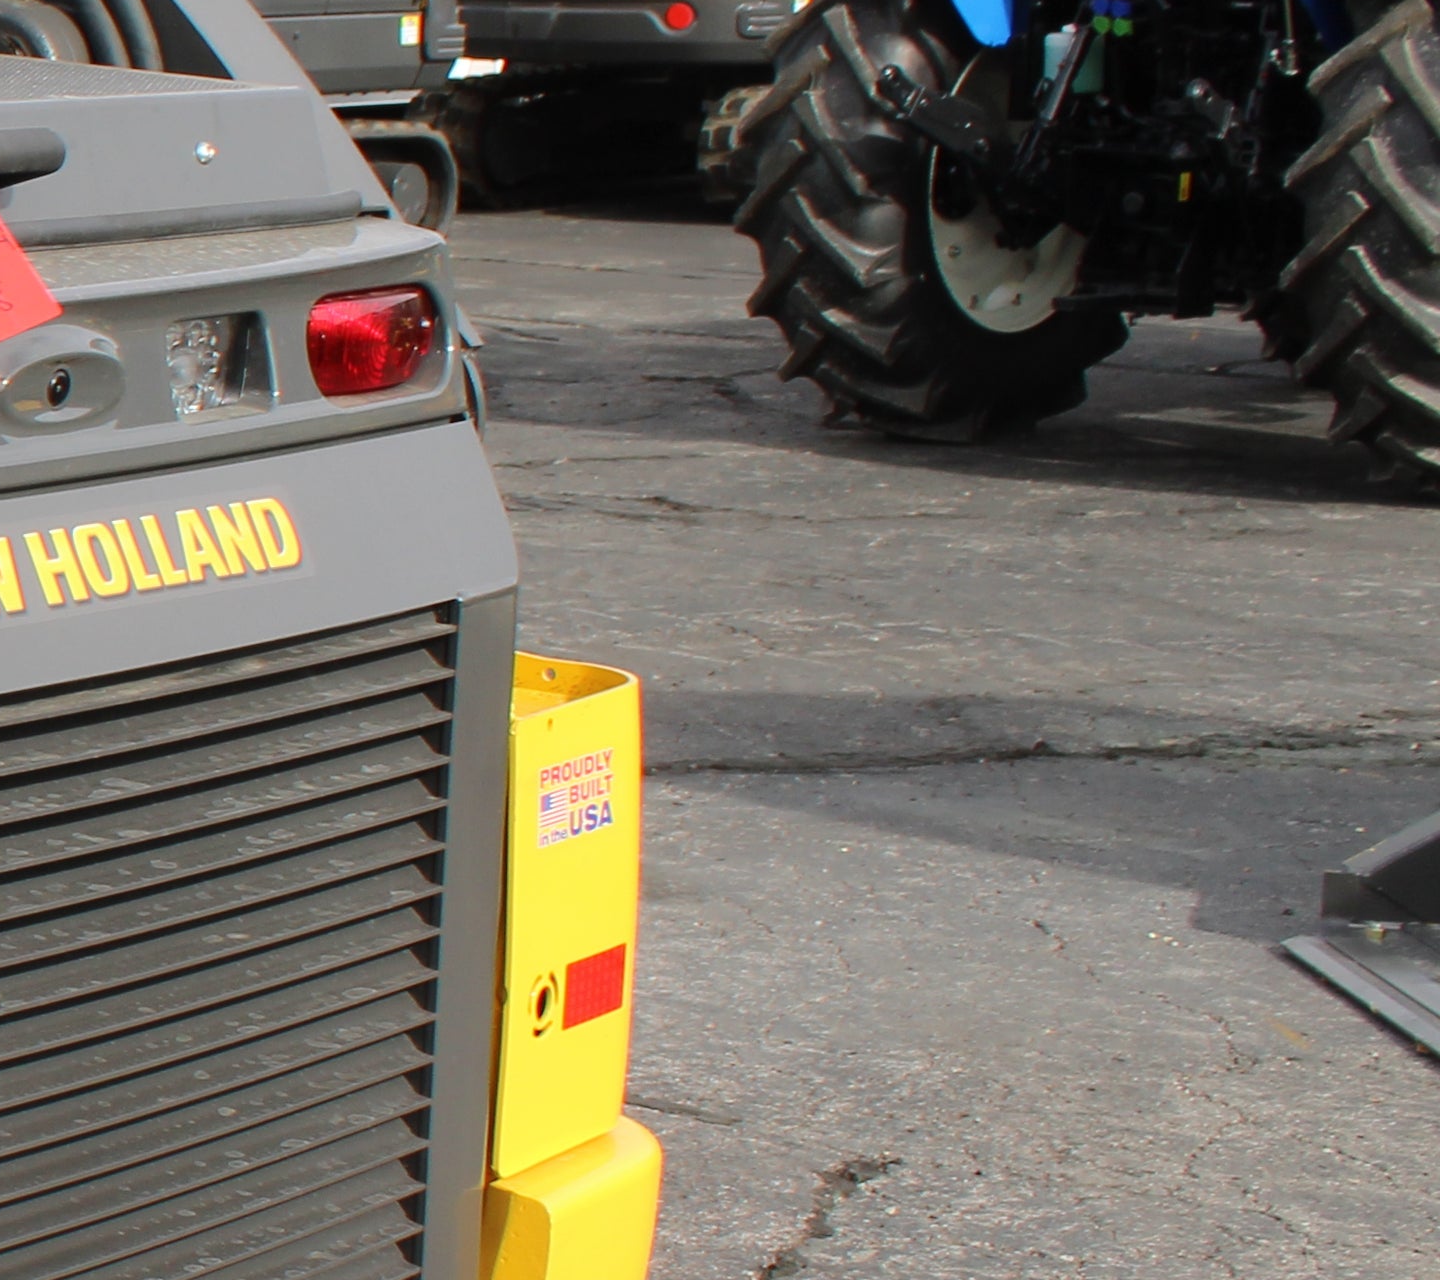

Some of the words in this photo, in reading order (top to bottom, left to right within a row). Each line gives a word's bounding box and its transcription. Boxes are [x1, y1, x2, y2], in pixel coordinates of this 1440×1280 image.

[23, 497, 304, 608] HOLLAND
[539, 750, 613, 789] PROUDLY
[569, 774, 613, 804] BUILT
[551, 828, 568, 841] the
[569, 800, 614, 836] USA
